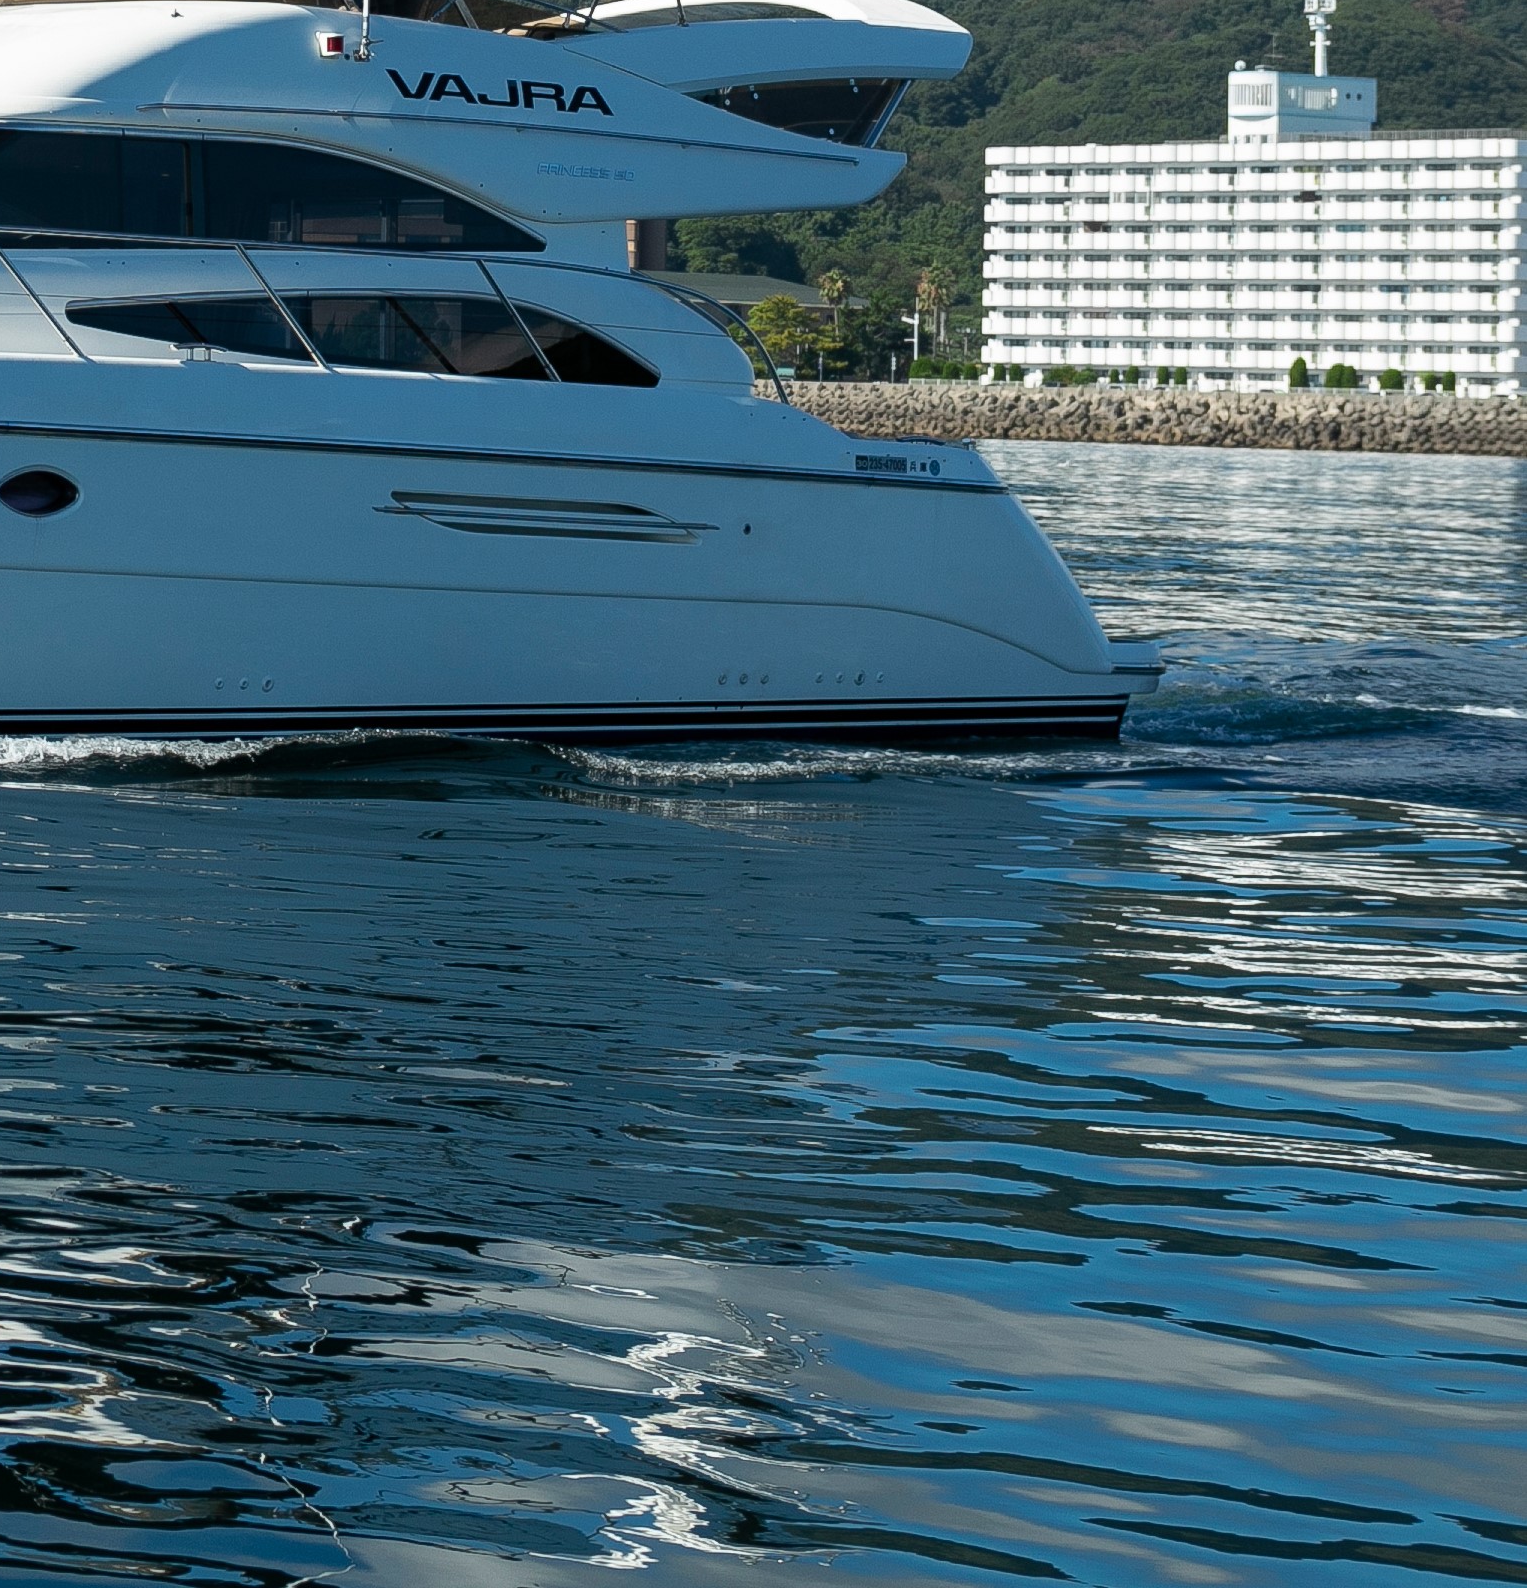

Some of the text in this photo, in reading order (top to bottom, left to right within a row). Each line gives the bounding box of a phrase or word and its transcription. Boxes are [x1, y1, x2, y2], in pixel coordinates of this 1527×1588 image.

[384, 68, 615, 117] VAJRA
[537, 161, 635, 182] PRINCESS 50
